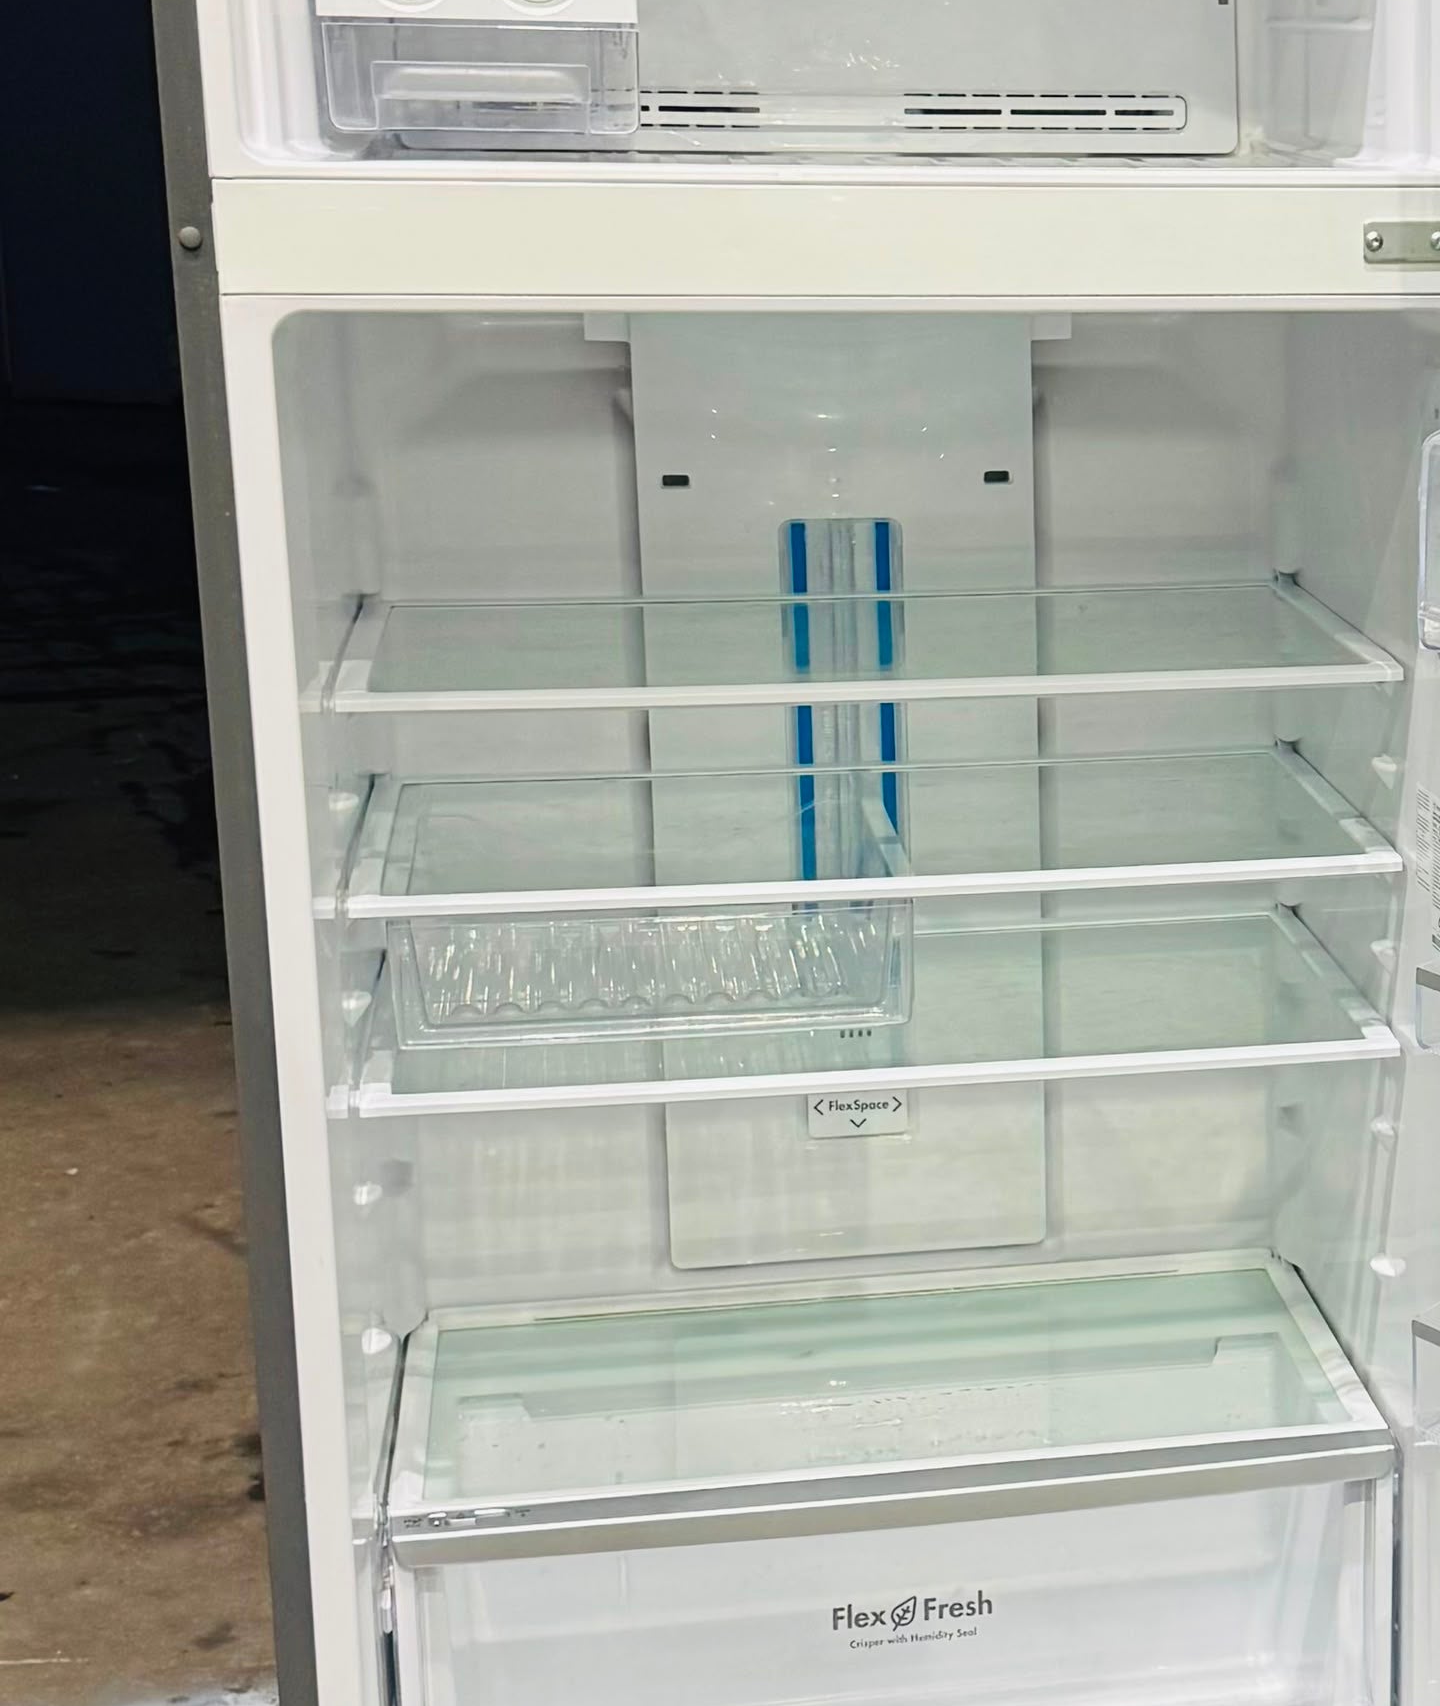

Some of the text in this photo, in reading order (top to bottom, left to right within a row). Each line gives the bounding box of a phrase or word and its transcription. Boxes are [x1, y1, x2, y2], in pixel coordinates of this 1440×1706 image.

[828, 1099, 889, 1113] FlexSpace
[832, 1589, 993, 1630] Flex Fresh
[850, 1639, 883, 1649] Crisper
[888, 1634, 908, 1644] with
[957, 1627, 977, 1638] Seal
